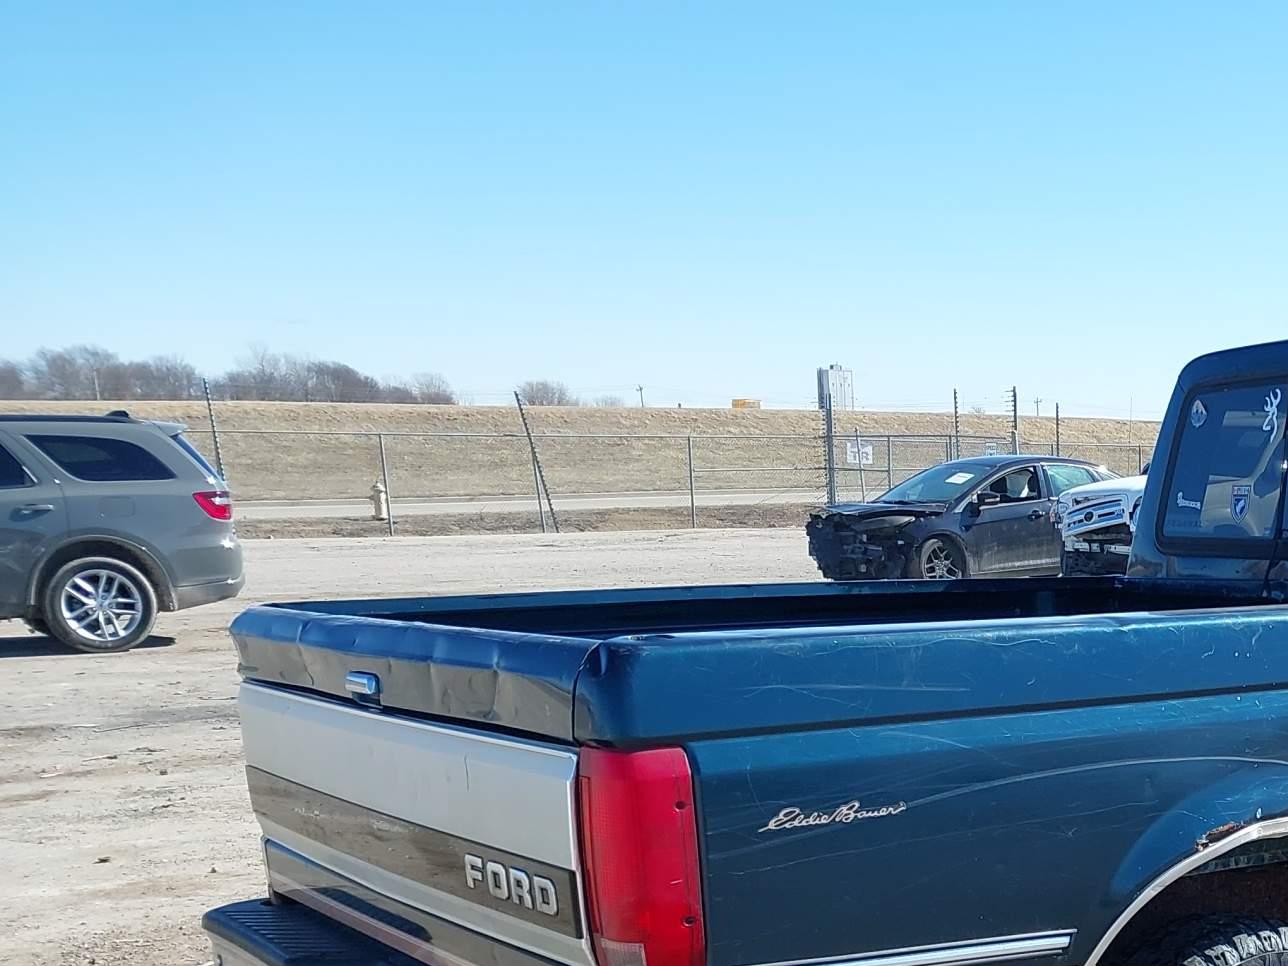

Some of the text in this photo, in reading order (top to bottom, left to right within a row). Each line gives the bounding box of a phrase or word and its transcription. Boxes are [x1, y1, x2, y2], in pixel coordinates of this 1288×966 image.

[758, 800, 907, 833] Eddie Bauer
[464, 853, 559, 916] FORD
